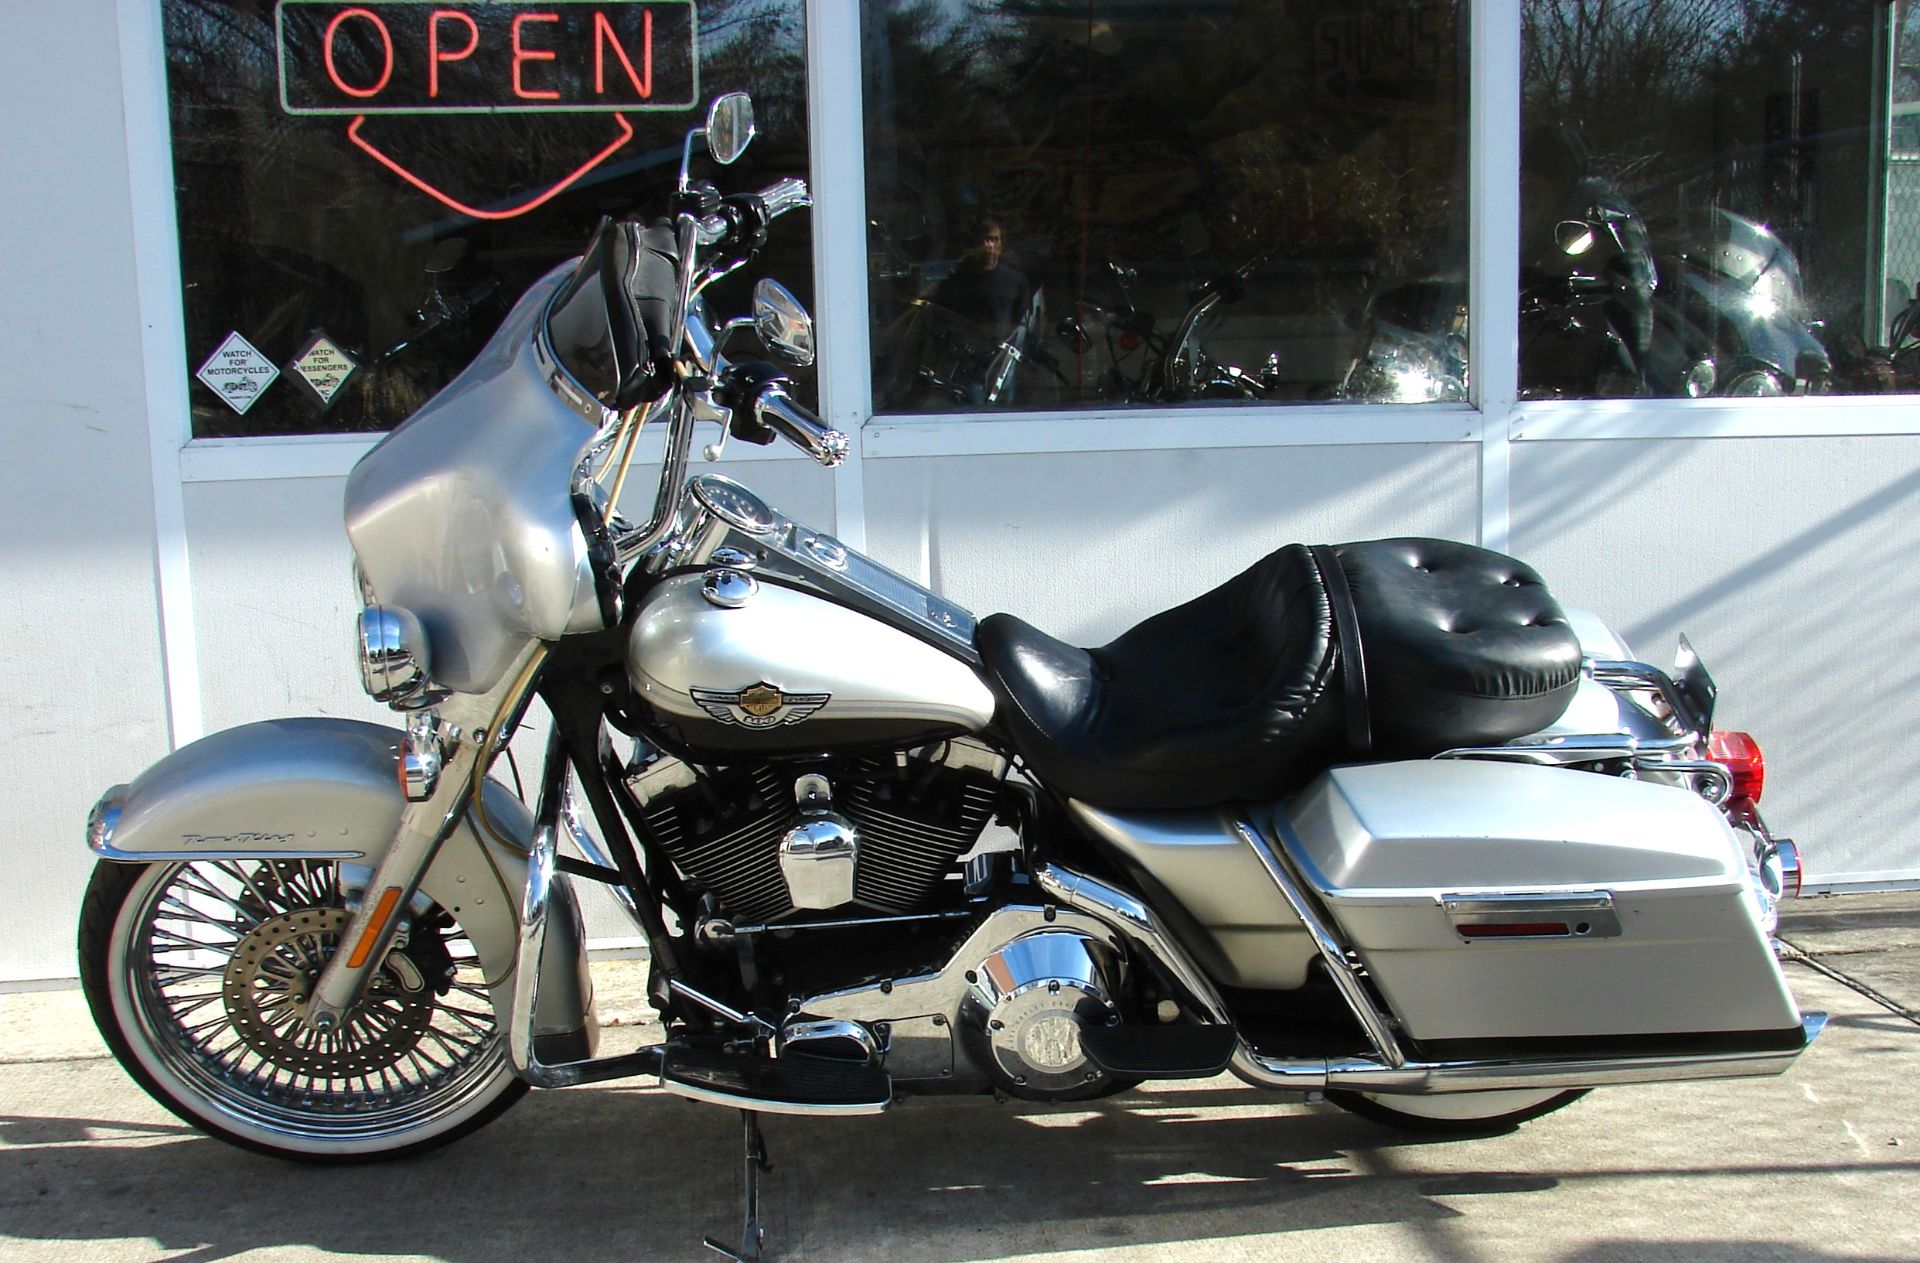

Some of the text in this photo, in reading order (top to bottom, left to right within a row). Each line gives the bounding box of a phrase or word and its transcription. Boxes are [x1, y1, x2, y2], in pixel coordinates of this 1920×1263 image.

[324, 8, 653, 99] OPEN
[223, 350, 252, 358] WATCH
[207, 366, 270, 375] MOTORCYCLES
